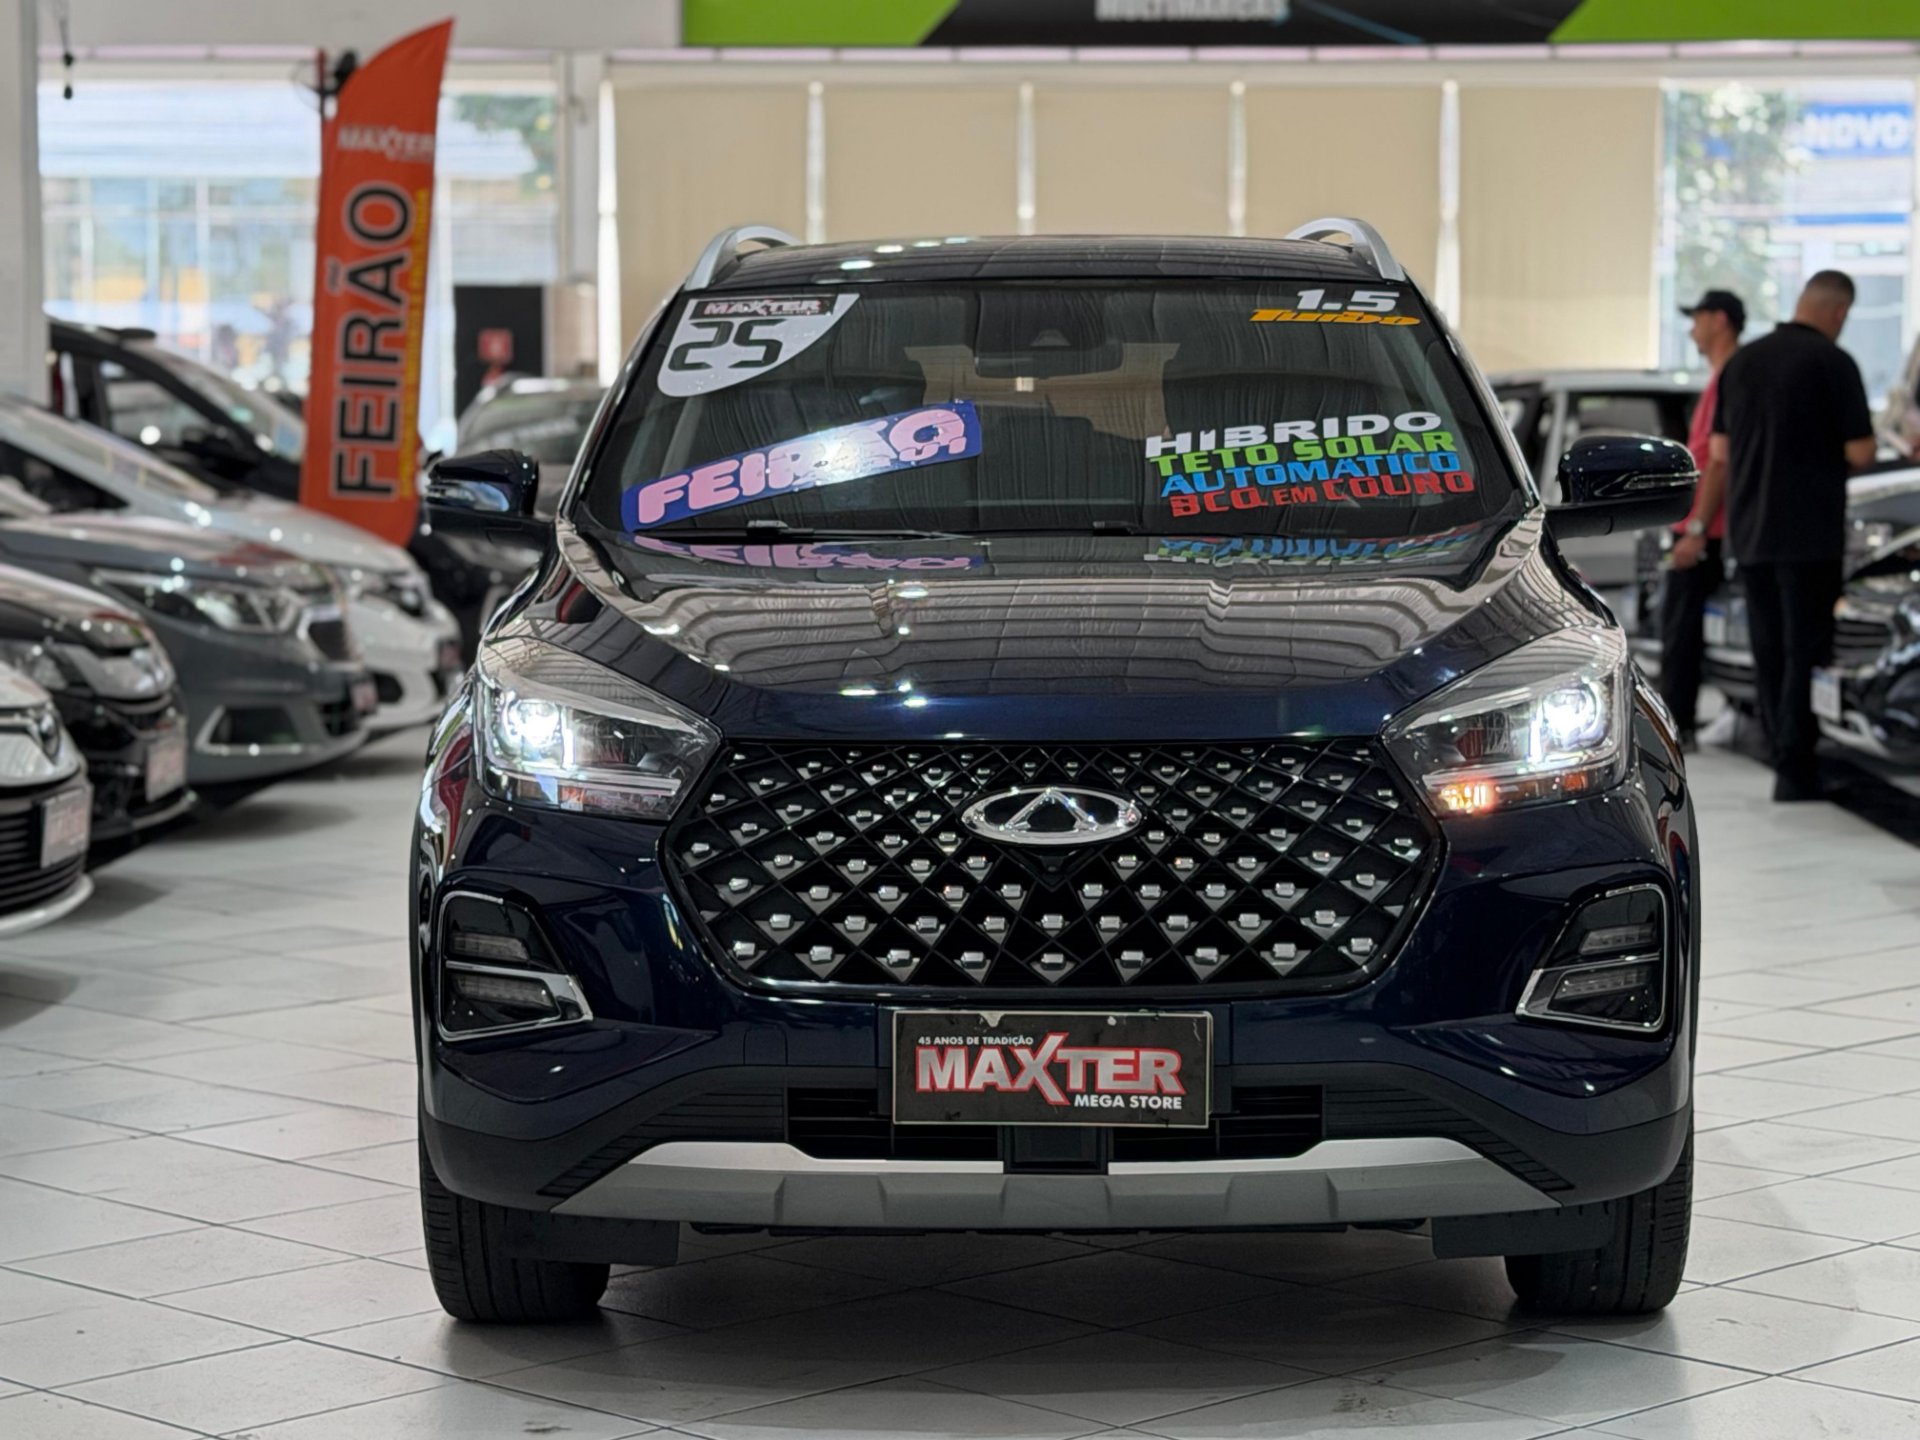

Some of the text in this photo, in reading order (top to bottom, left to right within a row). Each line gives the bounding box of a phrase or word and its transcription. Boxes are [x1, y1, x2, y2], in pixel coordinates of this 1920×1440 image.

[704, 299, 821, 316] MAXTER
[1297, 289, 1399, 312] 1.5
[325, 183, 414, 500] FEIRÃO
[668, 318, 787, 372] 25
[1149, 431, 1457, 477] TETO SOLAR
[1272, 486, 1318, 506] EM
[1322, 471, 1475, 500] COURO
[918, 1034, 1034, 1046] 45 ANOS DE TRADIÇÃO
[915, 1031, 1187, 1106] MAXTER
[1073, 1094, 1182, 1110] MEGA STORE
